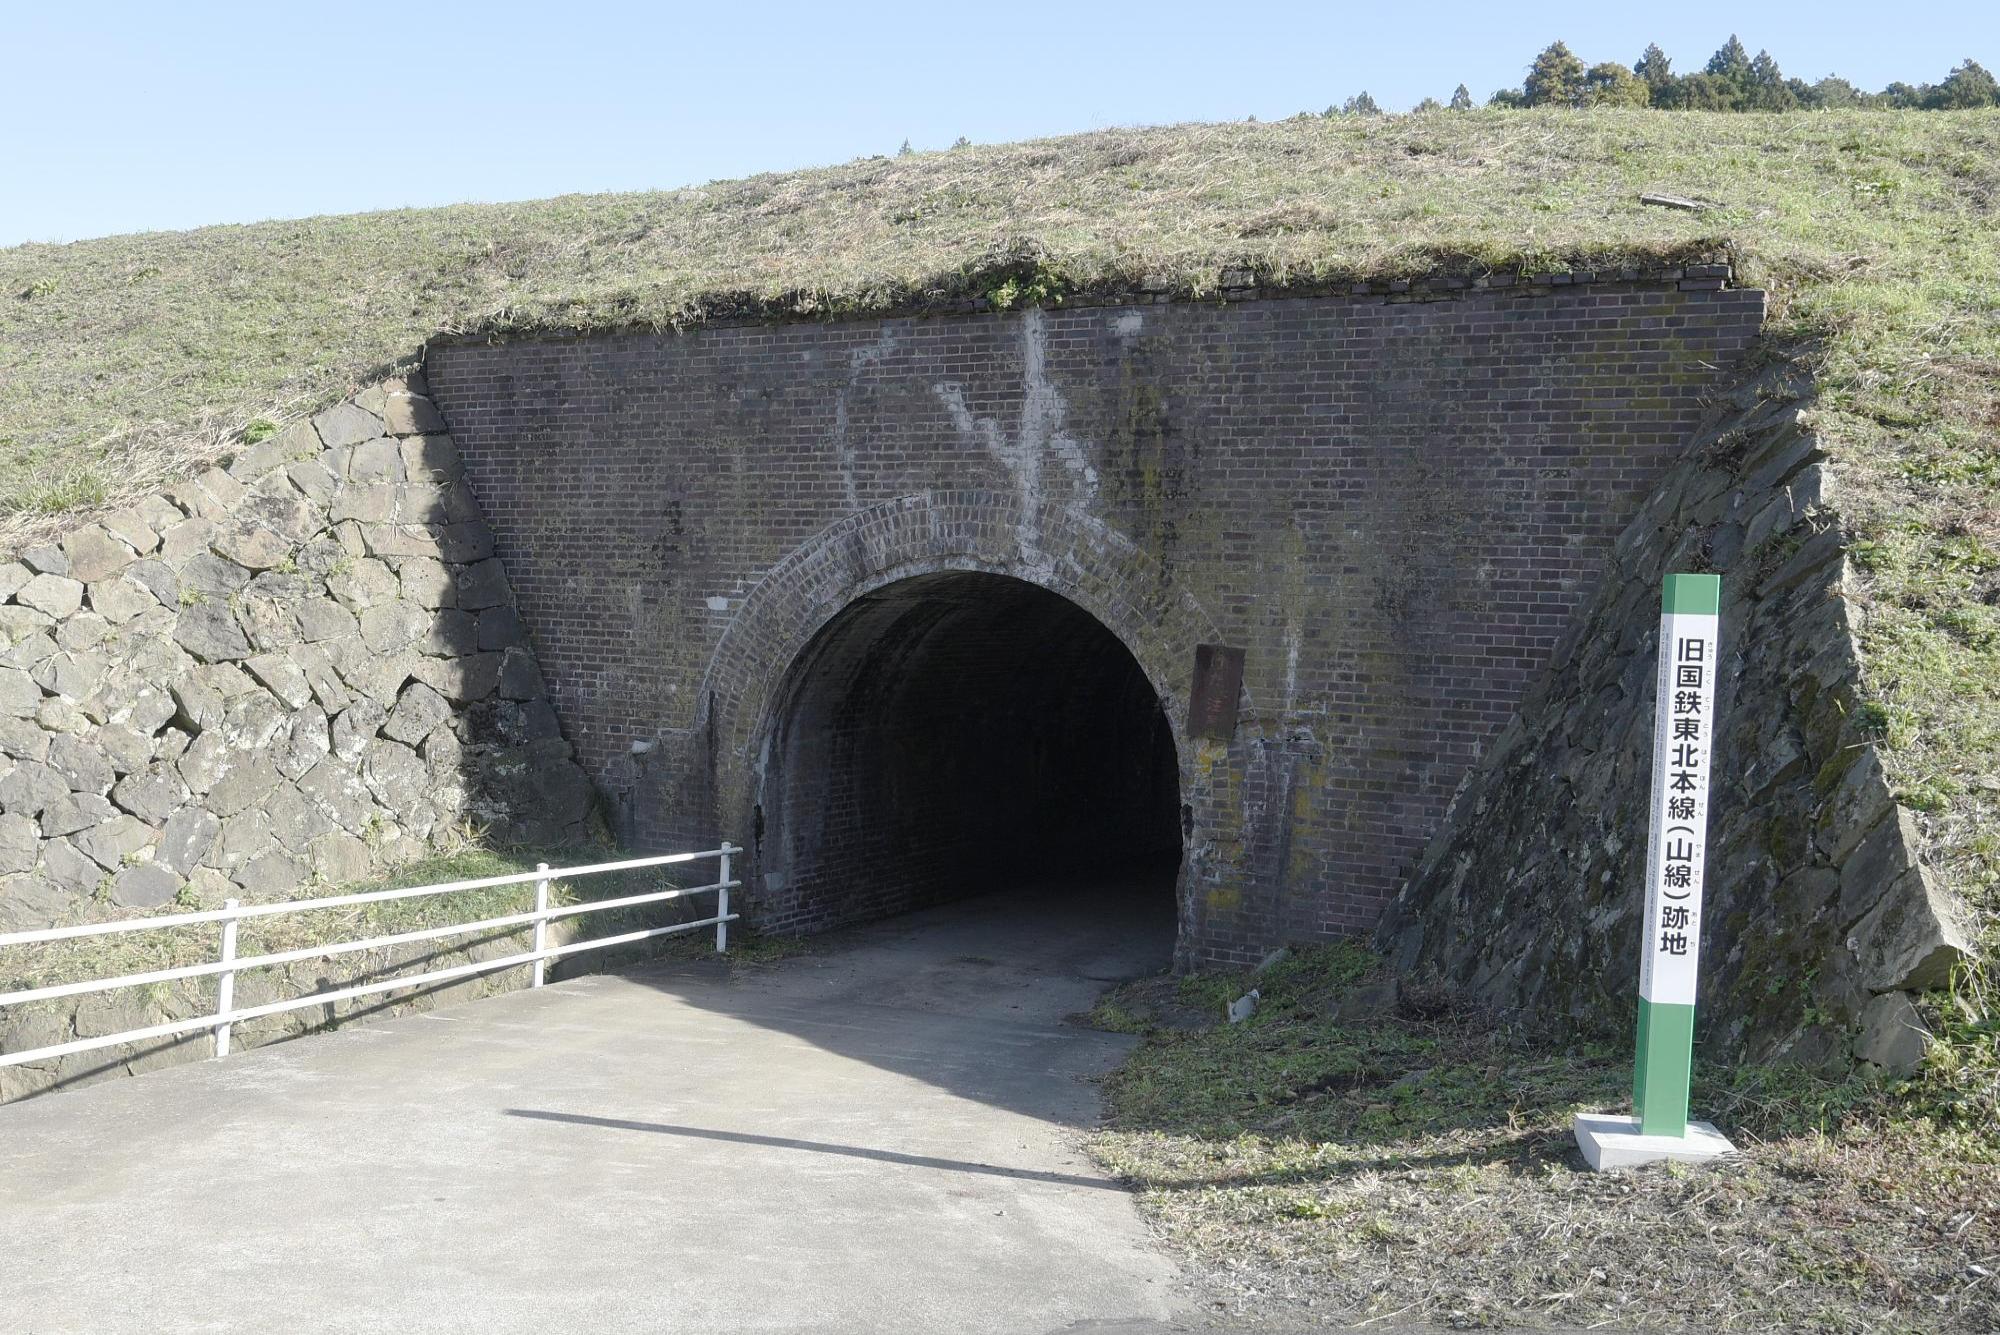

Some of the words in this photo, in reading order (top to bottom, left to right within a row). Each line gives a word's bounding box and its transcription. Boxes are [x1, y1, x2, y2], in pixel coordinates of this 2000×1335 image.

[1660, 637, 1704, 956] 旧国鉄東北本線（山線）跡地
